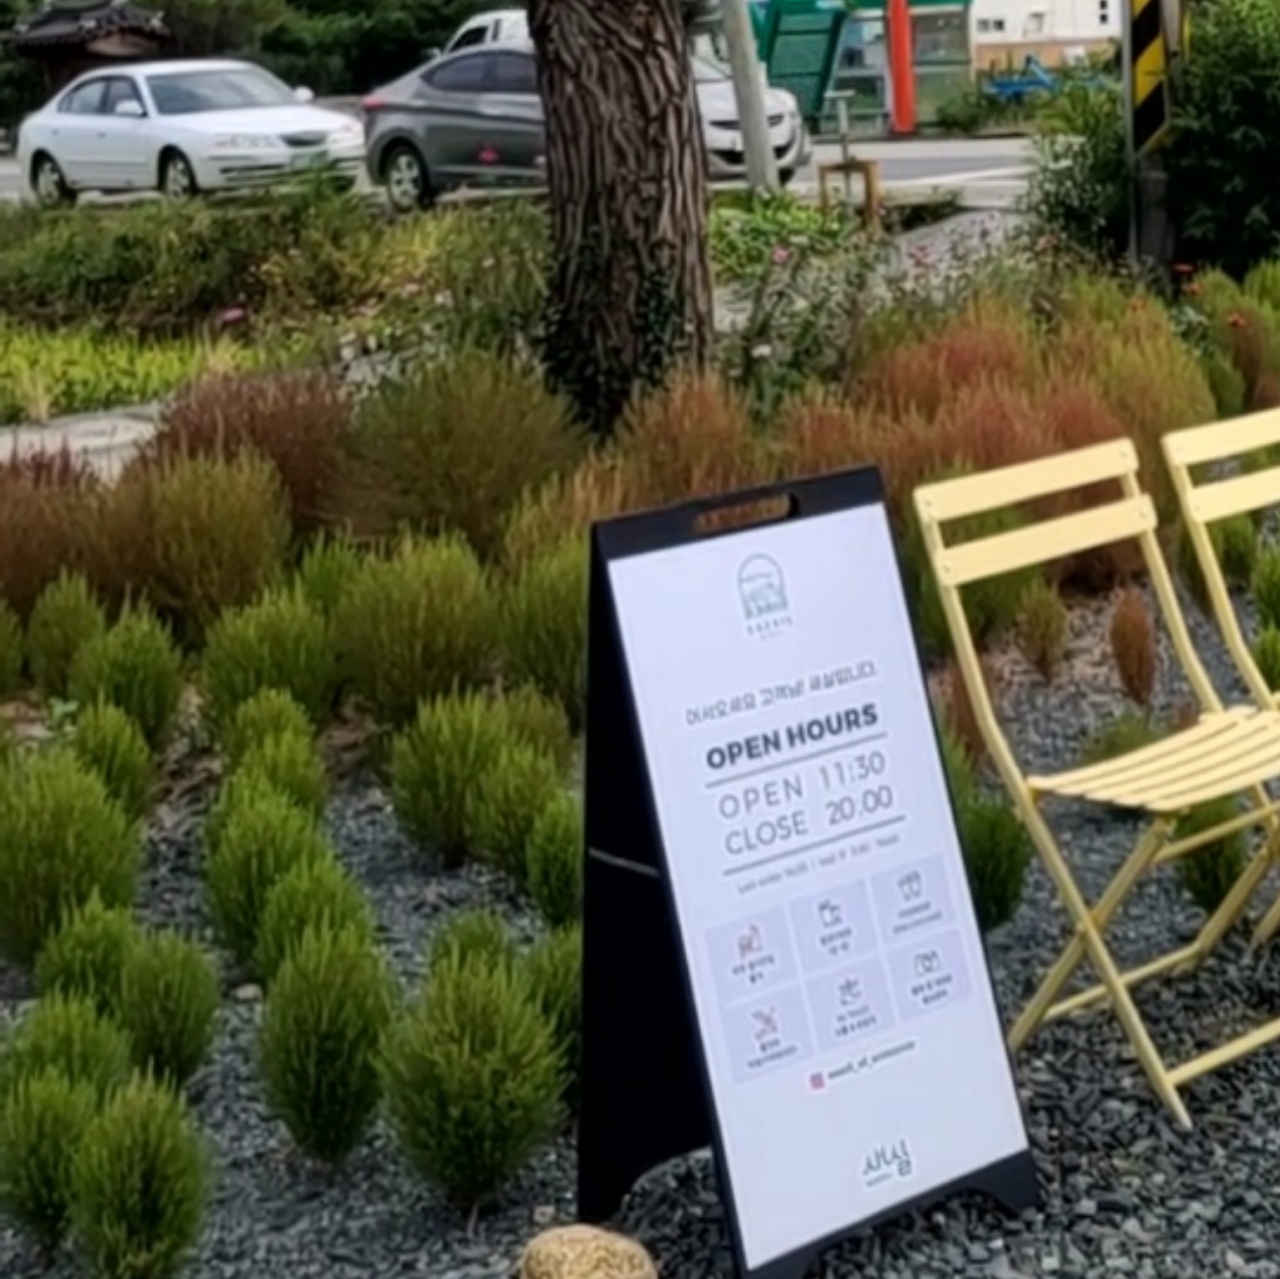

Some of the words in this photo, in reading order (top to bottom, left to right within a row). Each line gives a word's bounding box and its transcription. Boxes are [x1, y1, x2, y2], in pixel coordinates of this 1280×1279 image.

[685, 691, 757, 725] 어서오세요
[706, 729, 781, 770] OPEN
[786, 703, 878, 749] HOURS
[718, 773, 803, 820] OPEN
[819, 750, 886, 791] 11:30
[724, 809, 809, 856] CLOSE
